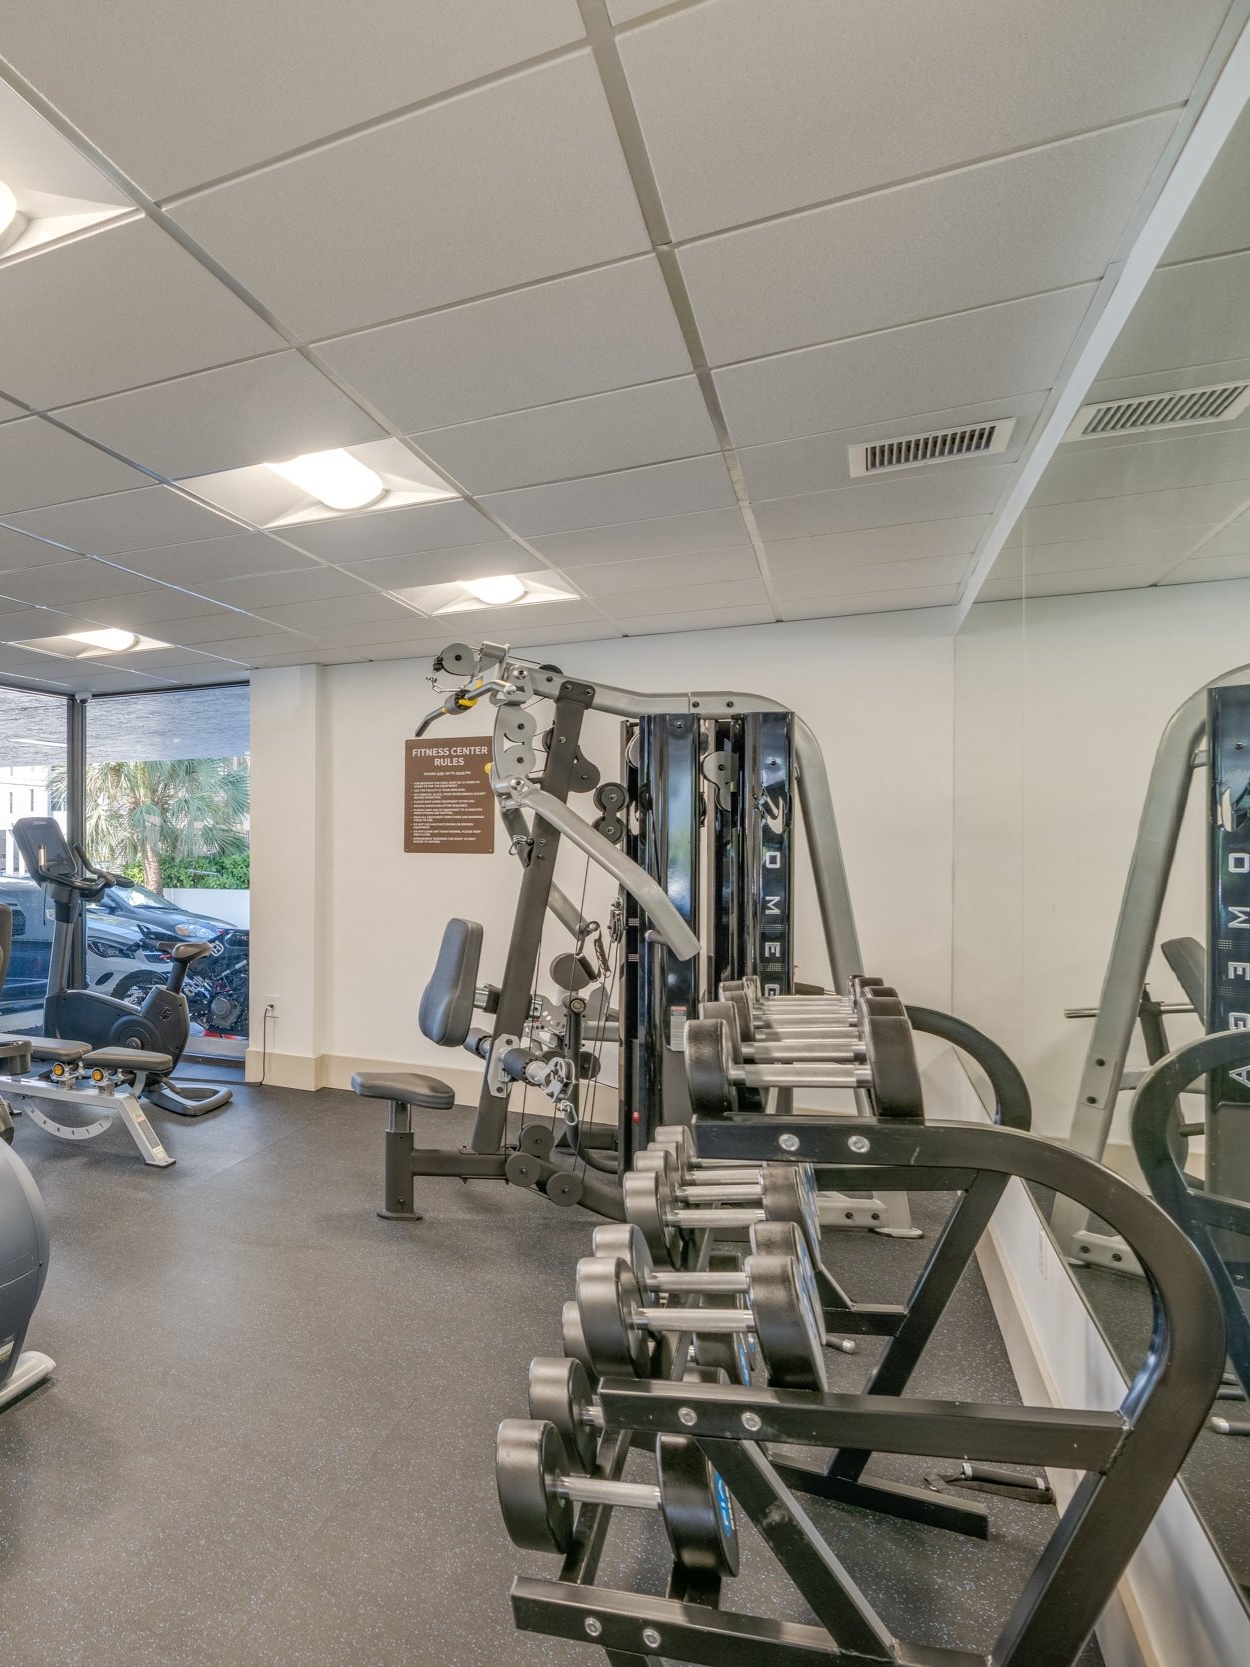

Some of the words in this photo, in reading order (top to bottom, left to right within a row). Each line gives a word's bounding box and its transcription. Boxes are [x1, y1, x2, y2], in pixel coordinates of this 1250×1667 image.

[412, 747, 449, 757] FITNESS
[450, 746, 488, 756] CENTER
[434, 757, 465, 766] RULES
[764, 851, 781, 997] OMEG
